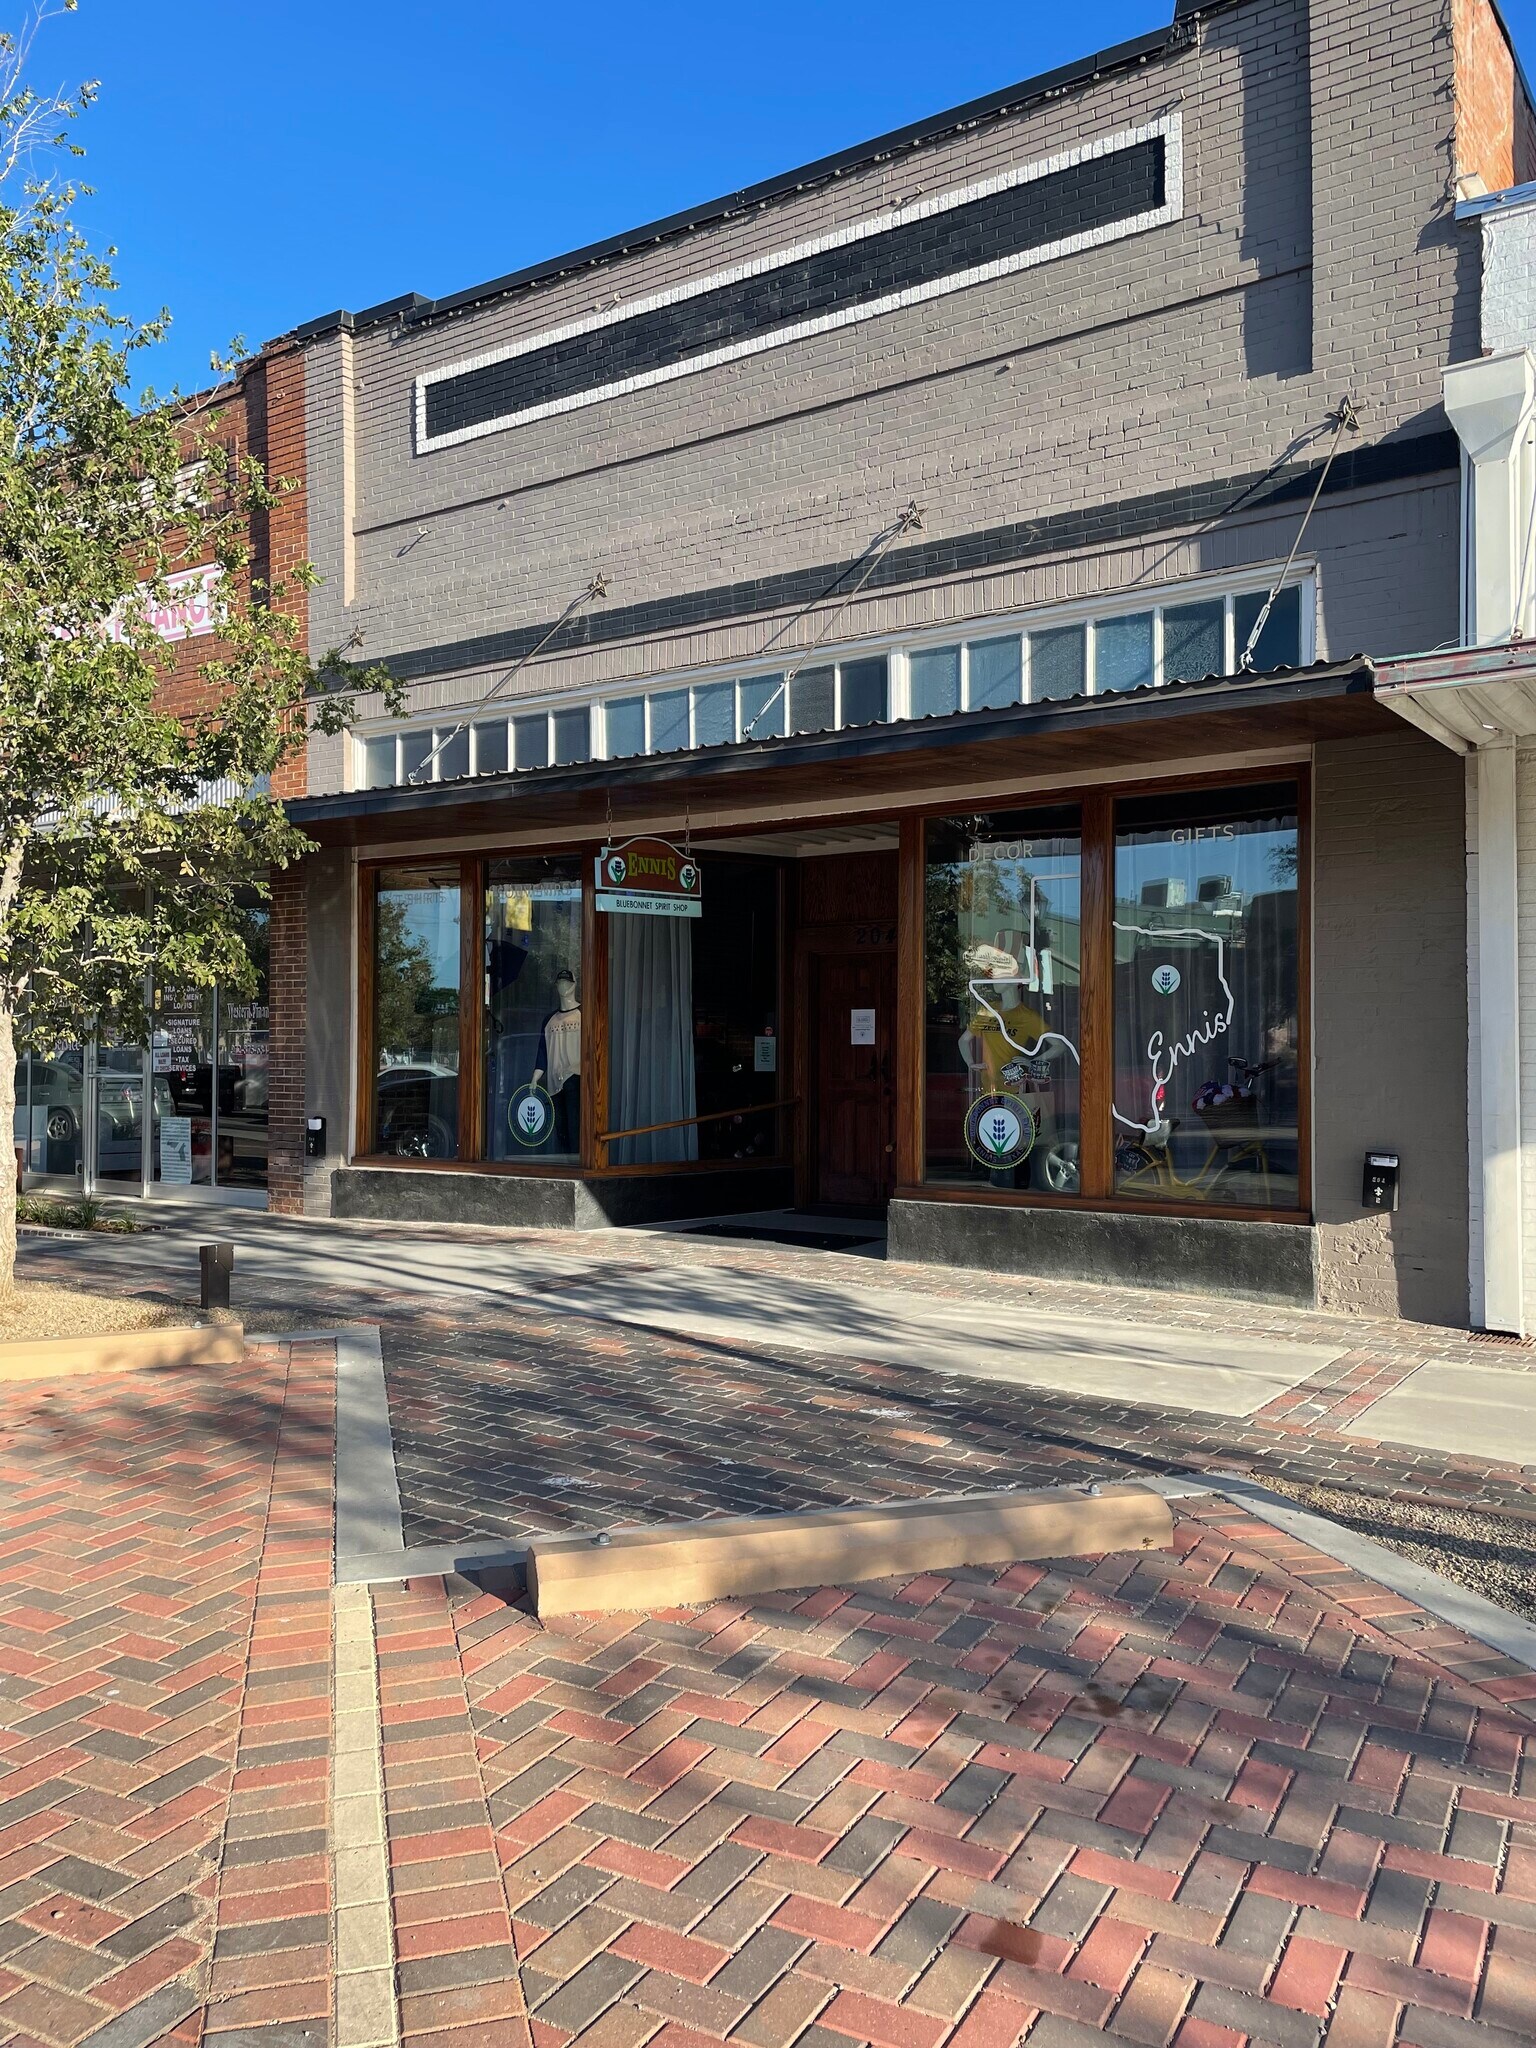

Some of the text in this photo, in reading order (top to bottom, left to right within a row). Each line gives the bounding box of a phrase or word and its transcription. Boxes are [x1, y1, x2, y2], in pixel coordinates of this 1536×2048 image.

[1171, 825, 1235, 846] GIFTS
[968, 843, 1033, 863] DECOR
[627, 852, 676, 881] ENNIS
[616, 899, 689, 912] BLUEBONNET SPIRIT SHOP
[167, 1018, 201, 1026] SIGNATURE
[173, 1027, 192, 1035] LOANS
[170, 1037, 198, 1045] SECURED
[1147, 1012, 1227, 1085] Ennis
[168, 1064, 197, 1072] SERVICES
